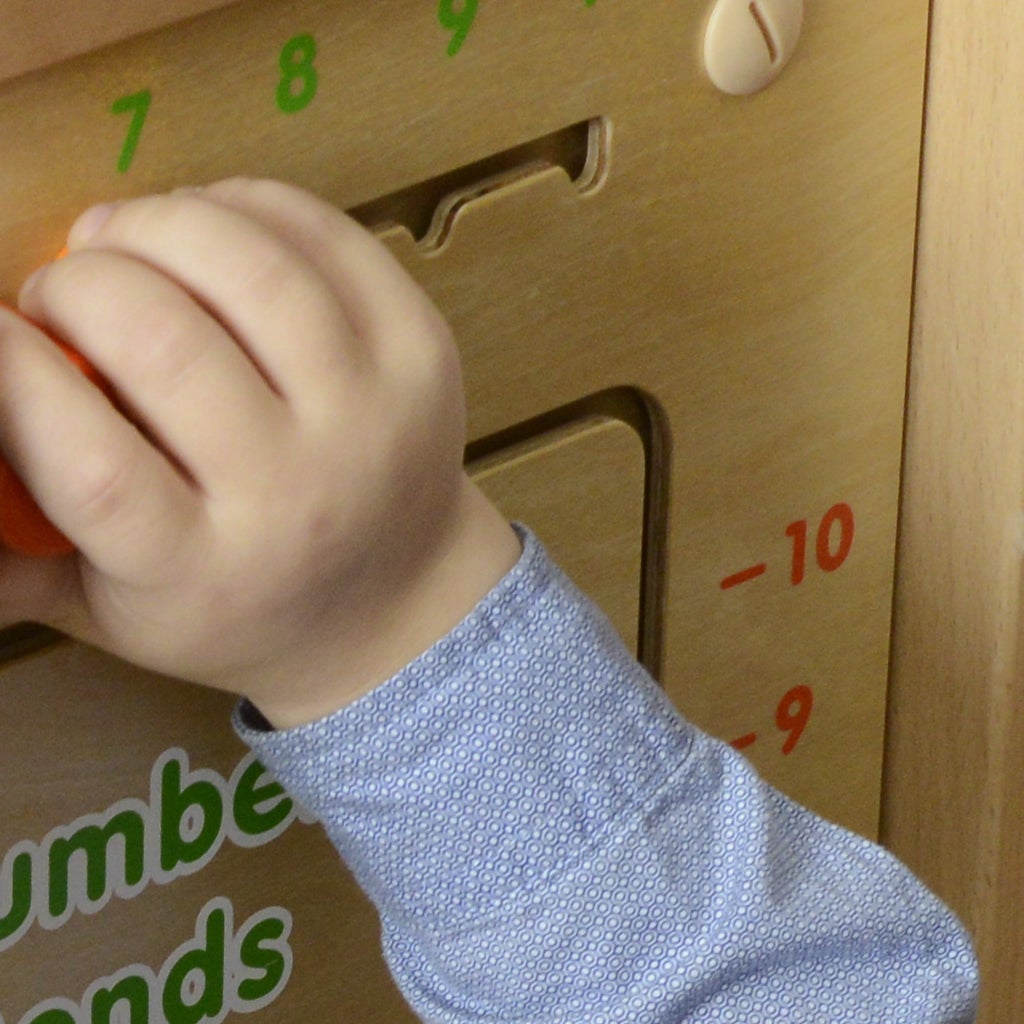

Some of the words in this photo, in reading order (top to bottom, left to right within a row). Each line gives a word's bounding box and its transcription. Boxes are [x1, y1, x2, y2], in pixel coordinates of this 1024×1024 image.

[109, 89, 153, 174] 7
[272, 32, 320, 117] 8
[436, 0, 479, 58] 9
